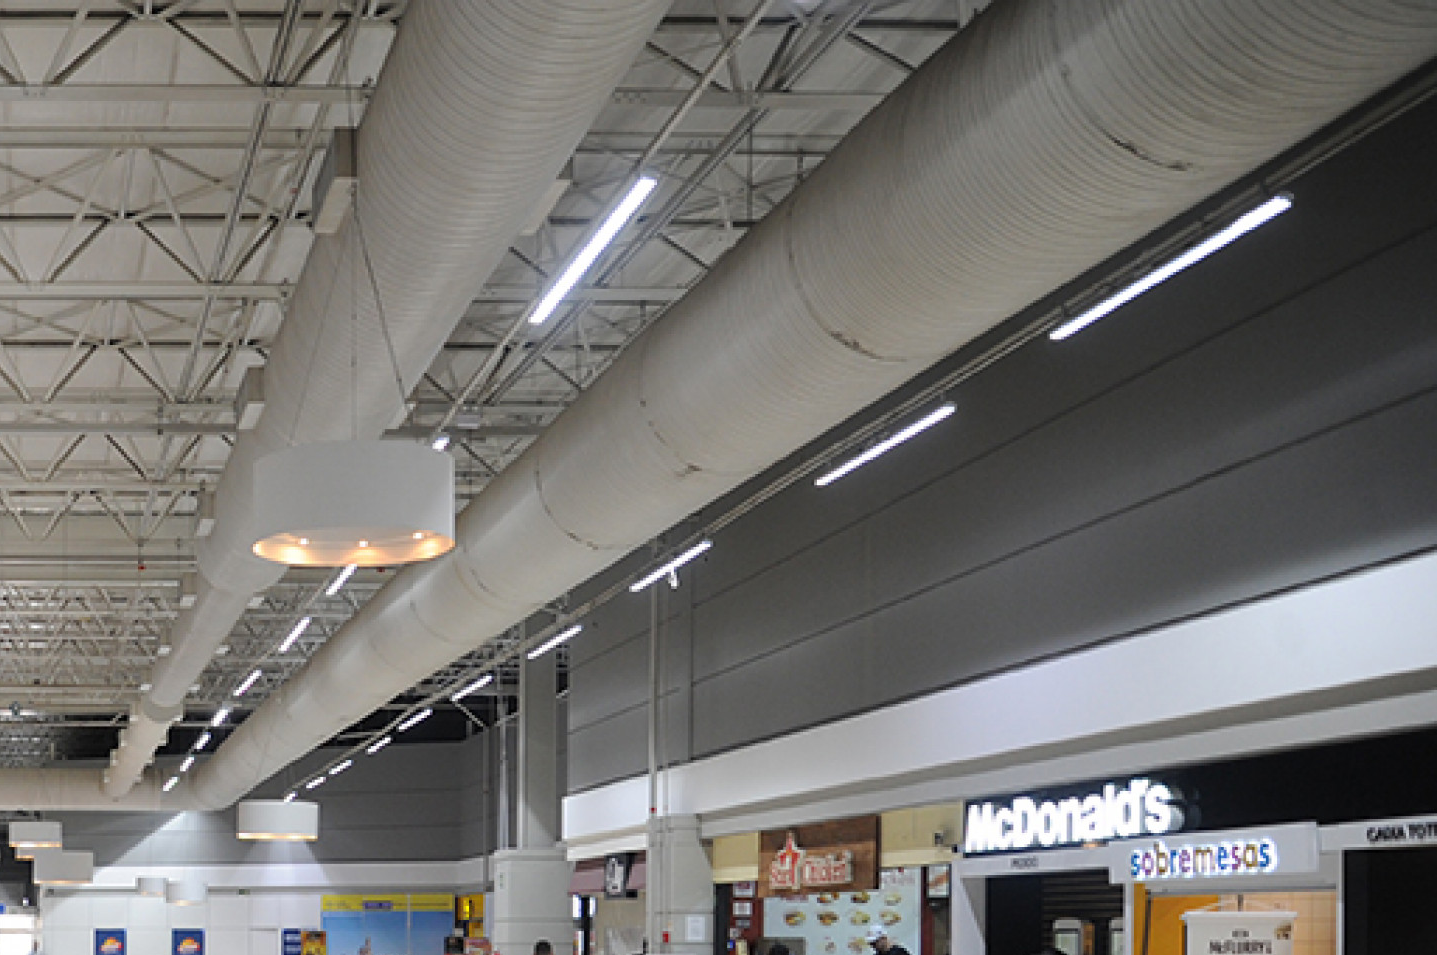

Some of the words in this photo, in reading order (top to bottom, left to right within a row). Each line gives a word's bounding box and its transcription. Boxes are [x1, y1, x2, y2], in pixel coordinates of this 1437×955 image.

[965, 777, 1173, 854] McDonald's
[1365, 824, 1406, 843] CAIXA
[1408, 821, 1437, 840] TOT
[1129, 837, 1278, 881] sobremesas
